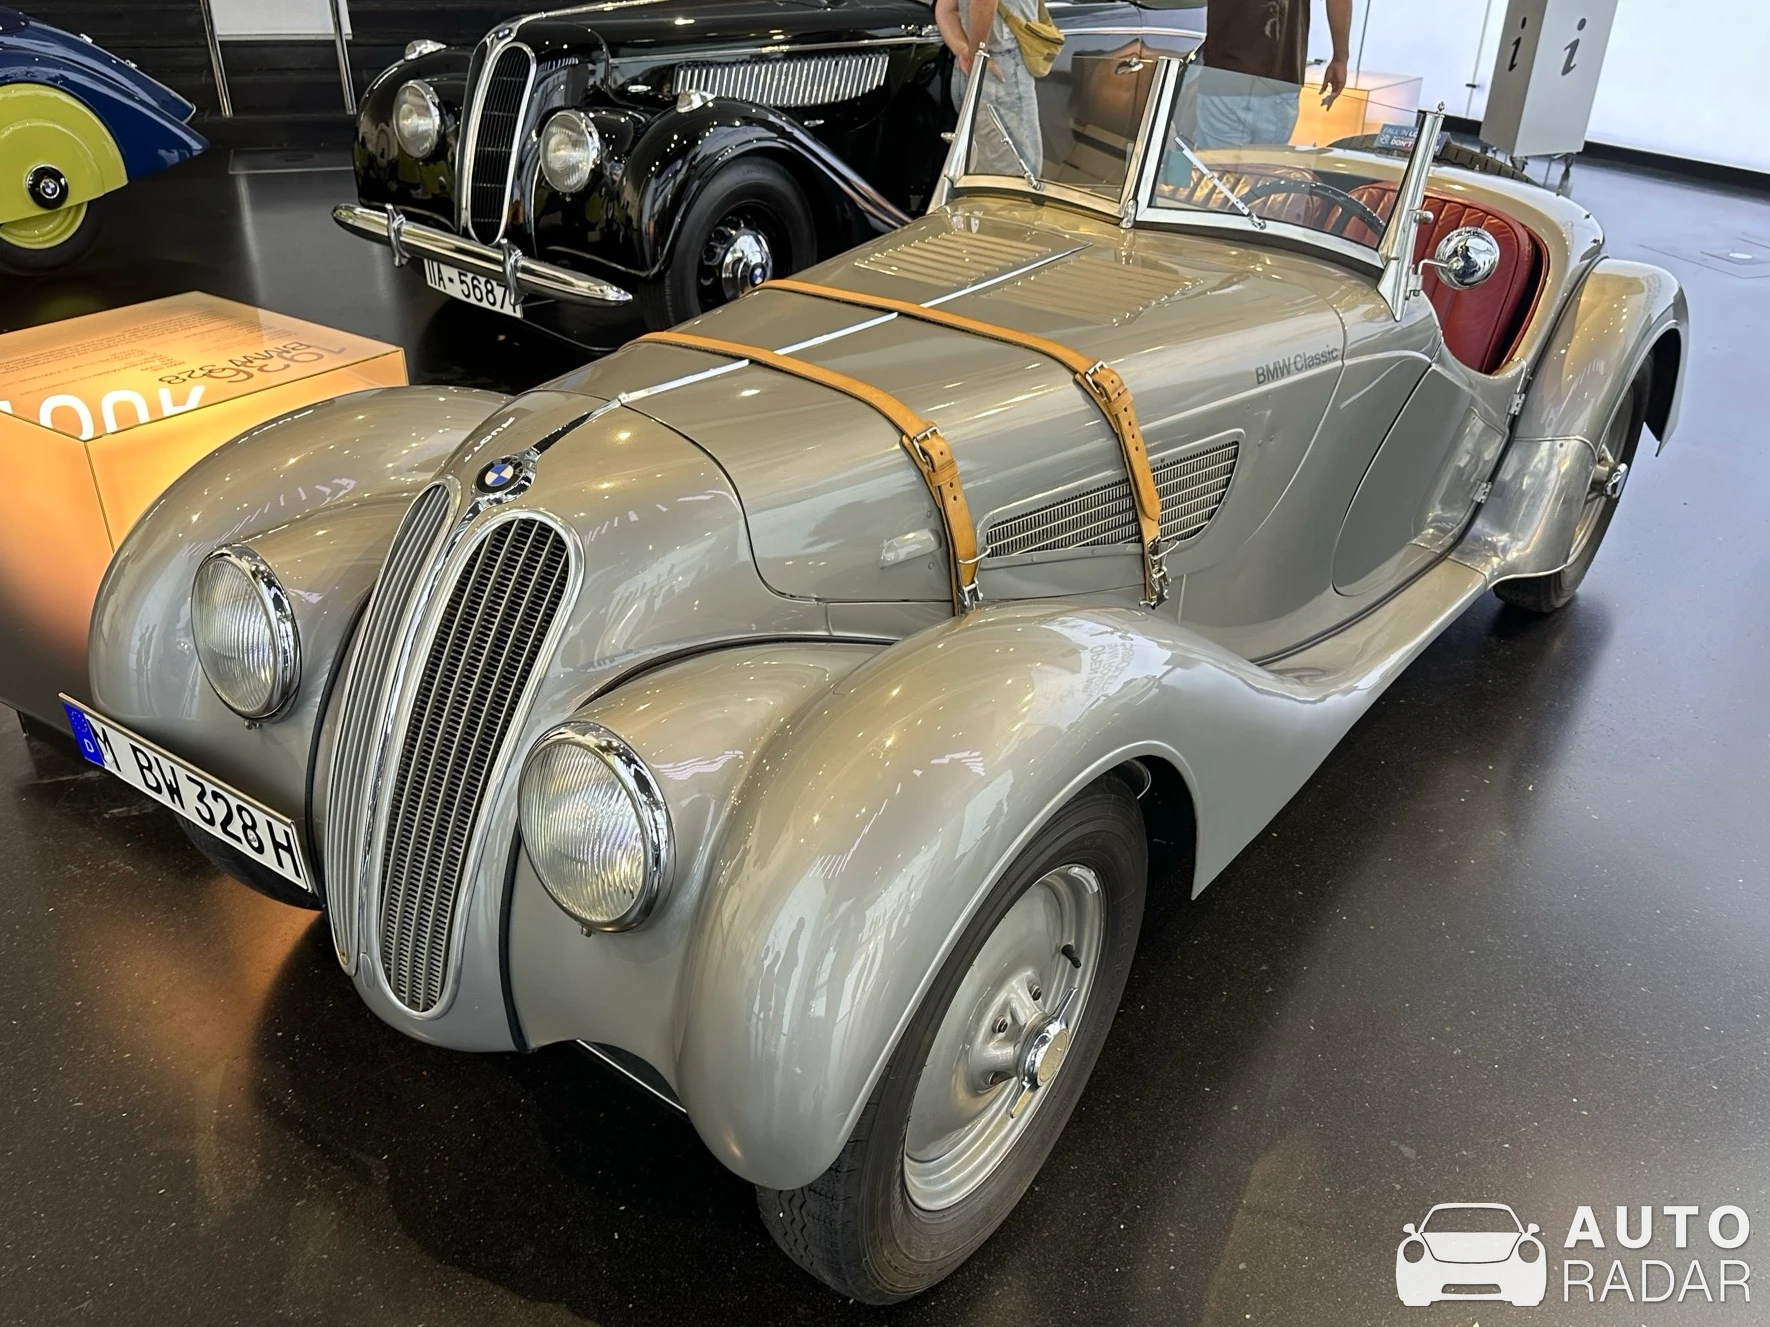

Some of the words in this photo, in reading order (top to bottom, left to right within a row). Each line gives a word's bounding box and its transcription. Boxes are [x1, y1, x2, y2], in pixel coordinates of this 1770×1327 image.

[228, 341, 311, 367] BMW
[1255, 357, 1291, 386] BMW
[1293, 344, 1339, 372] Classic
[83, 738, 95, 753] D
[86, 719, 122, 772] M
[129, 743, 185, 810] BW
